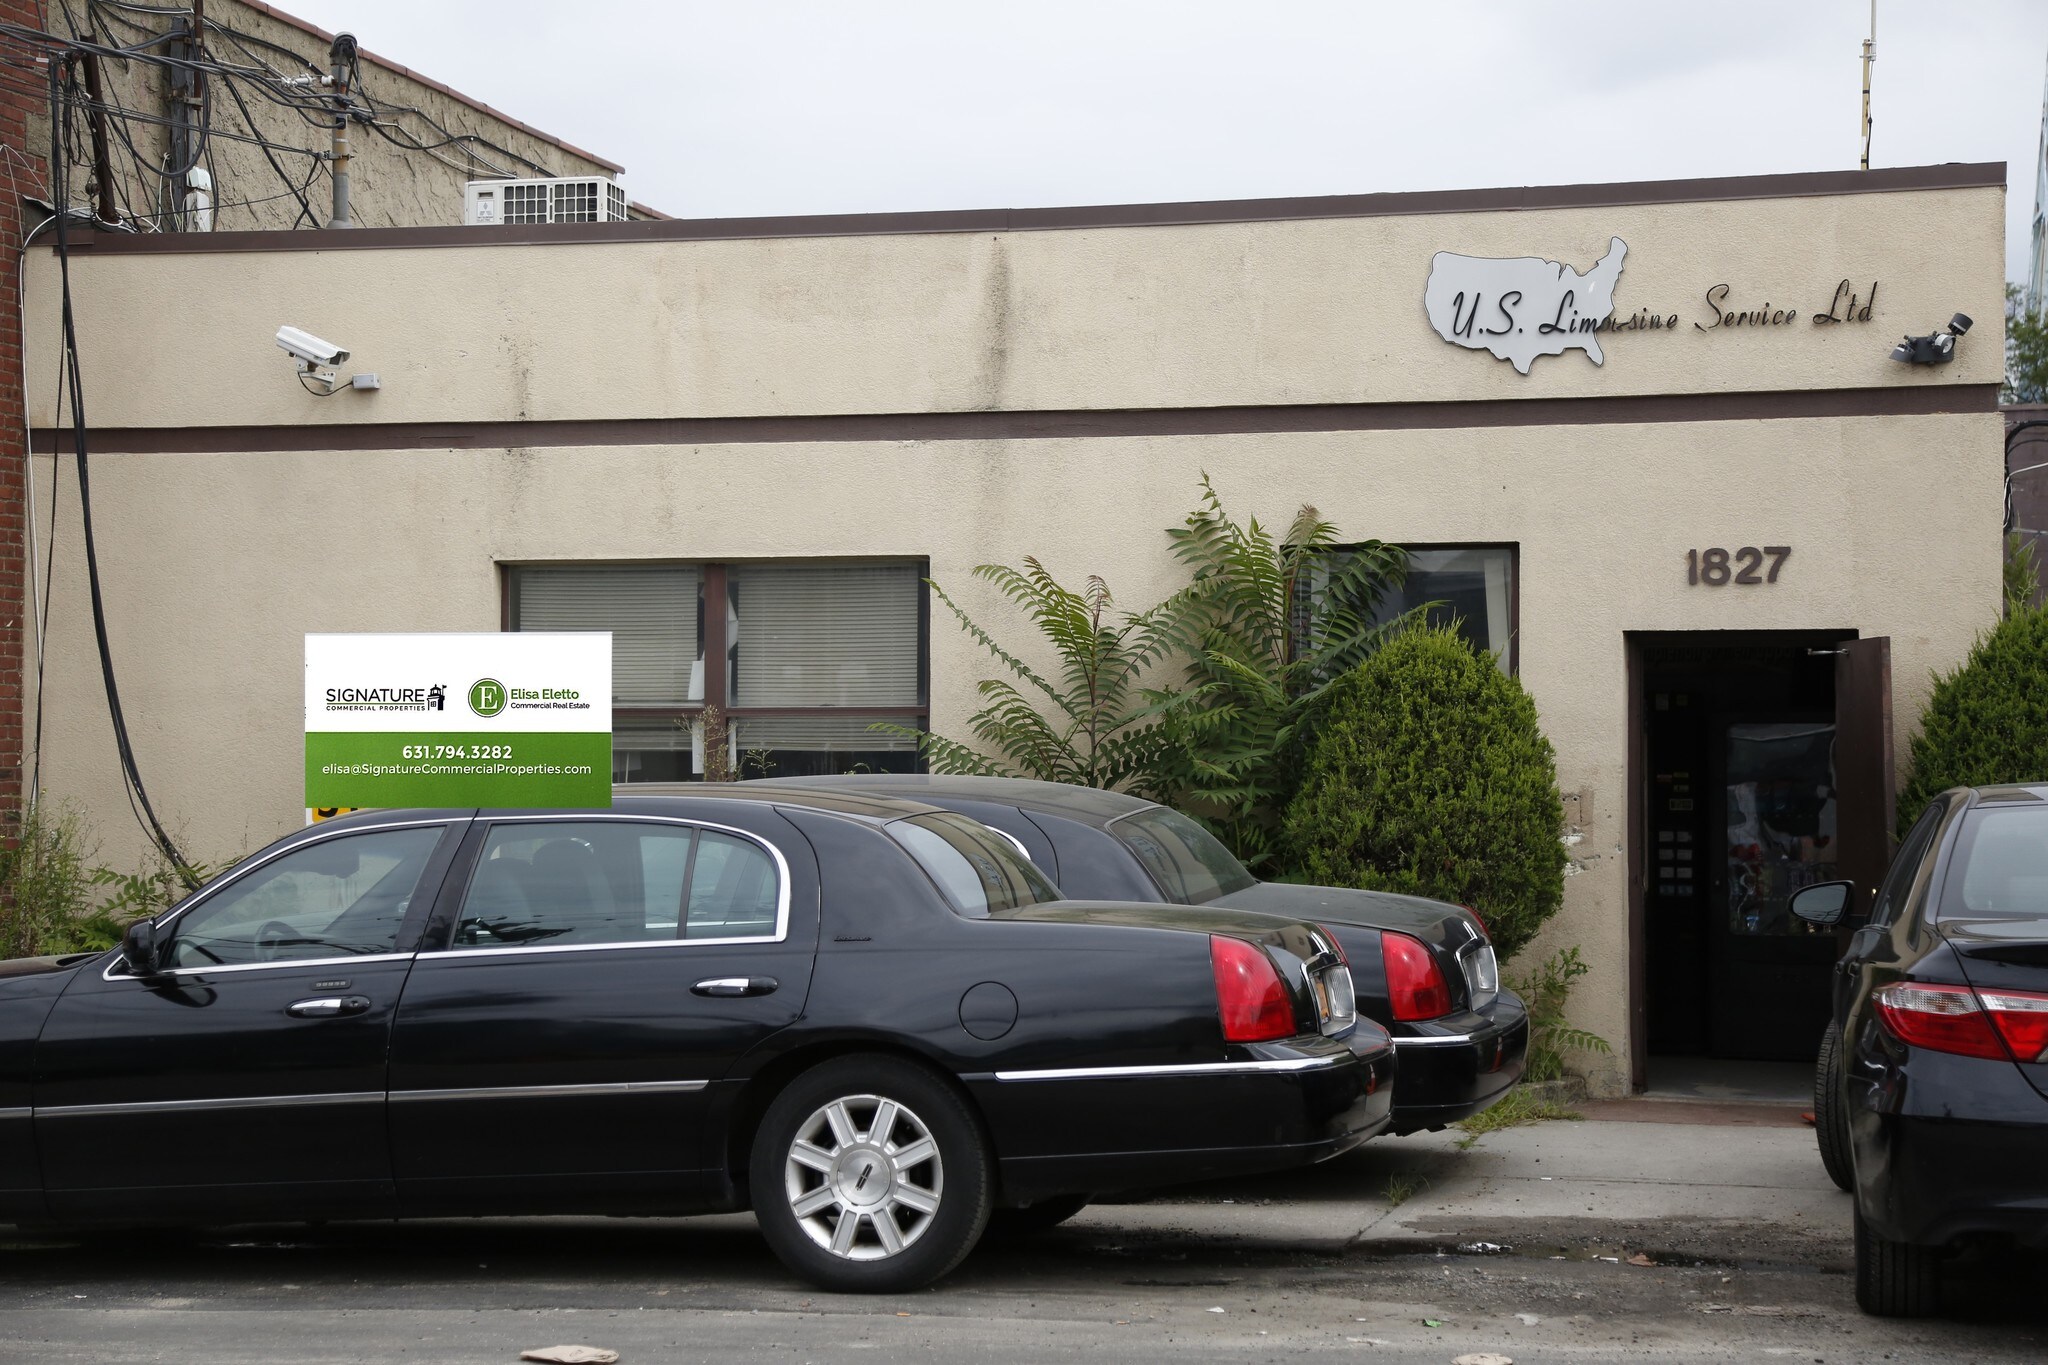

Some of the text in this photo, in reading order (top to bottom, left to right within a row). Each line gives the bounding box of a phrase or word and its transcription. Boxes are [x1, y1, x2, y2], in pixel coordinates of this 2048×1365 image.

[1453, 278, 1878, 339] U.S. Limousine Service Ltd
[1688, 546, 1792, 586] 1827
